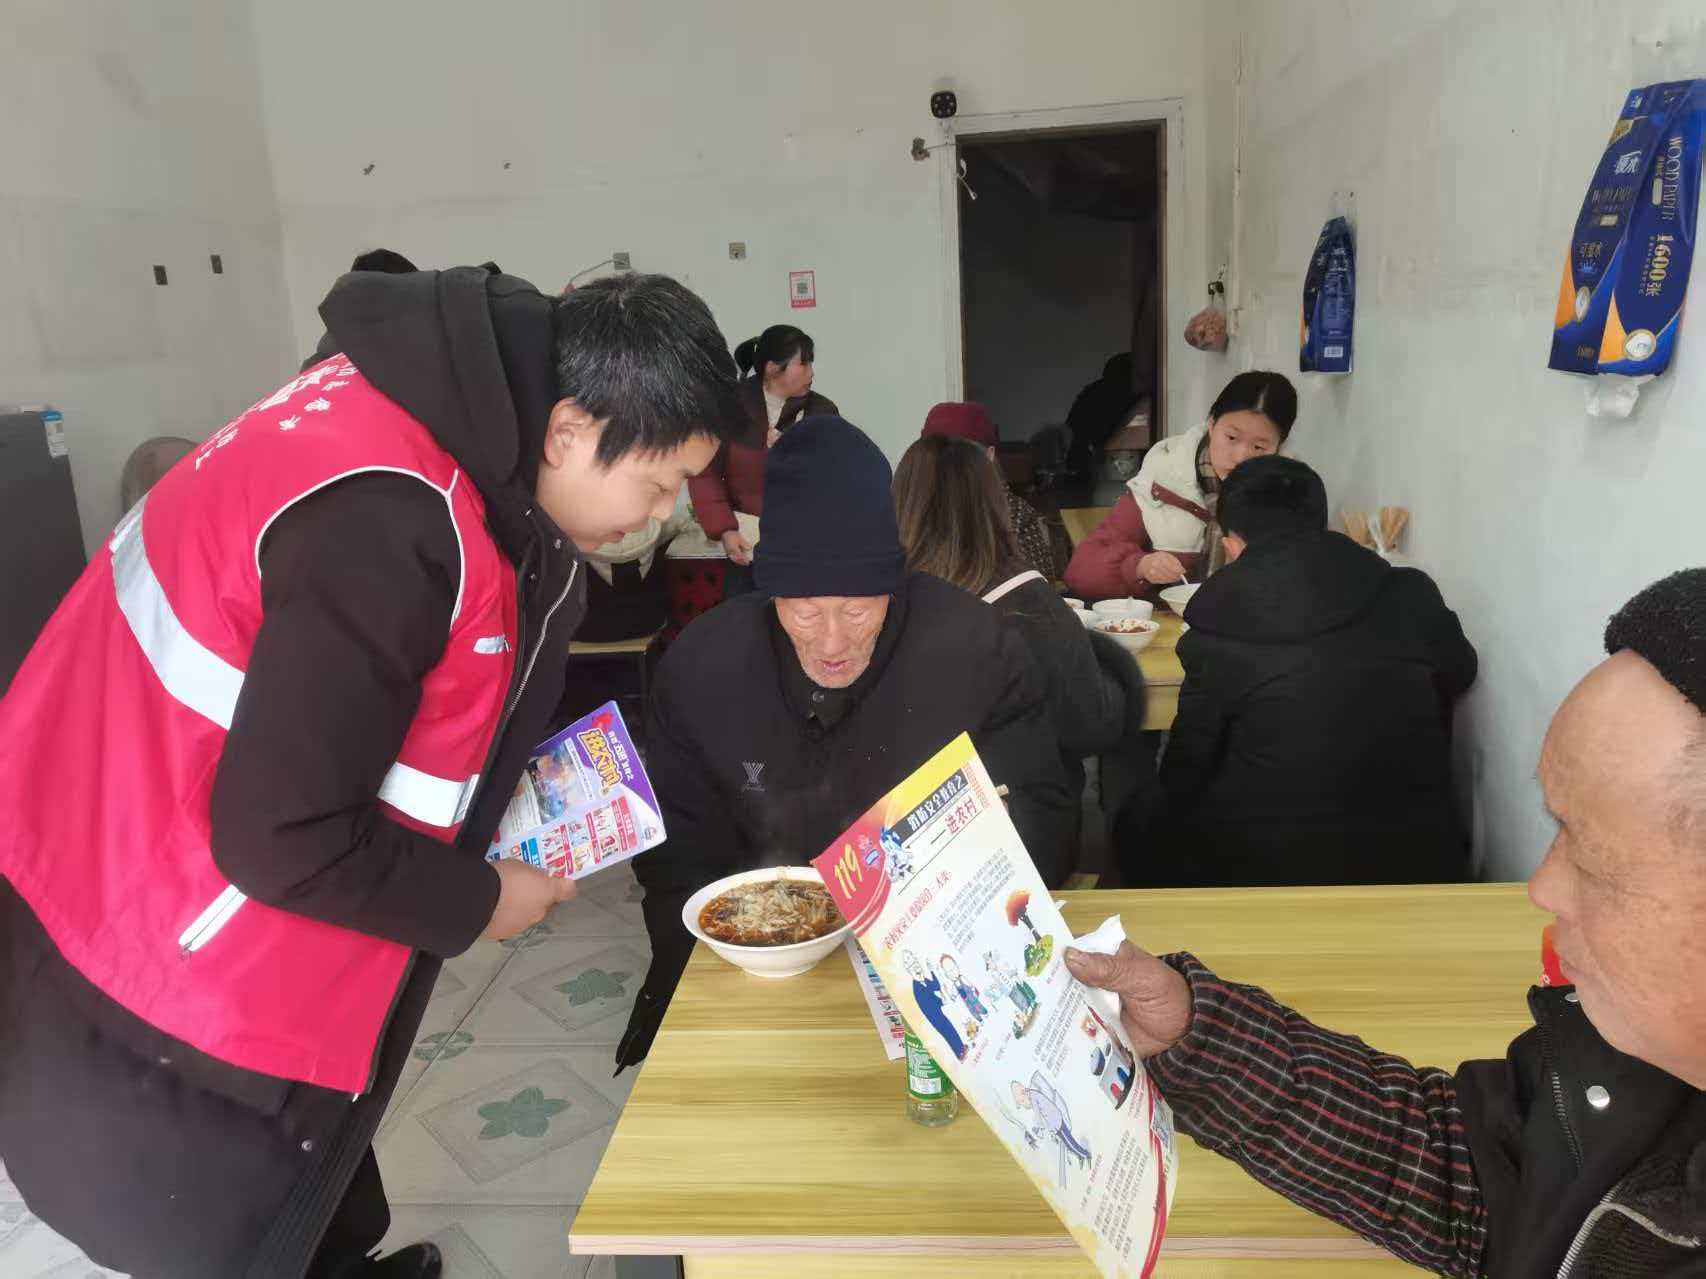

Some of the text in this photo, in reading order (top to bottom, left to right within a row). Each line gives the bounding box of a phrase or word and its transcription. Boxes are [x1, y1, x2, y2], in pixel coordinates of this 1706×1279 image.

[1664, 135, 1682, 180] WOOD
[906, 774, 965, 832] 消防安全教育之
[834, 843, 863, 899] 119
